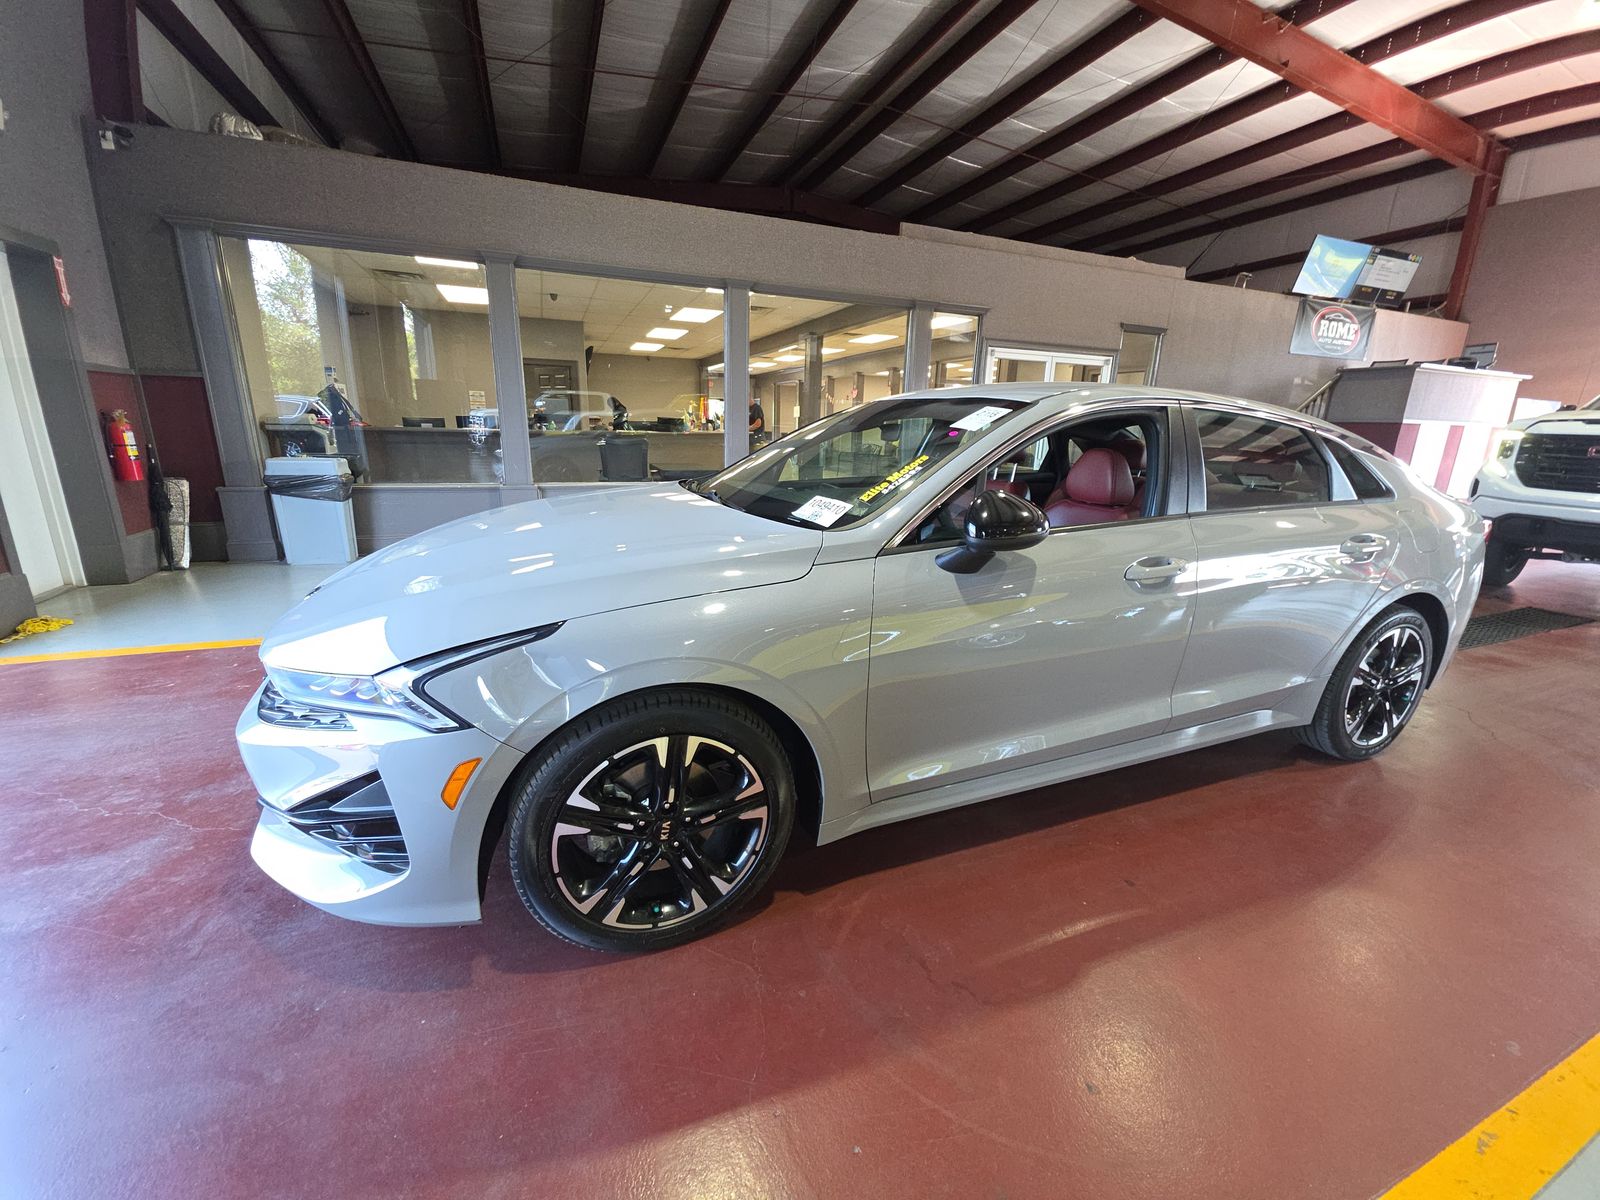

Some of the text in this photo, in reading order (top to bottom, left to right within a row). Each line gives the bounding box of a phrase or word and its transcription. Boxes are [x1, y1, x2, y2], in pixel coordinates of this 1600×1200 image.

[1317, 320, 1359, 340] ROME
[858, 454, 930, 503] Elite Motors
[660, 820, 672, 841] KIA
